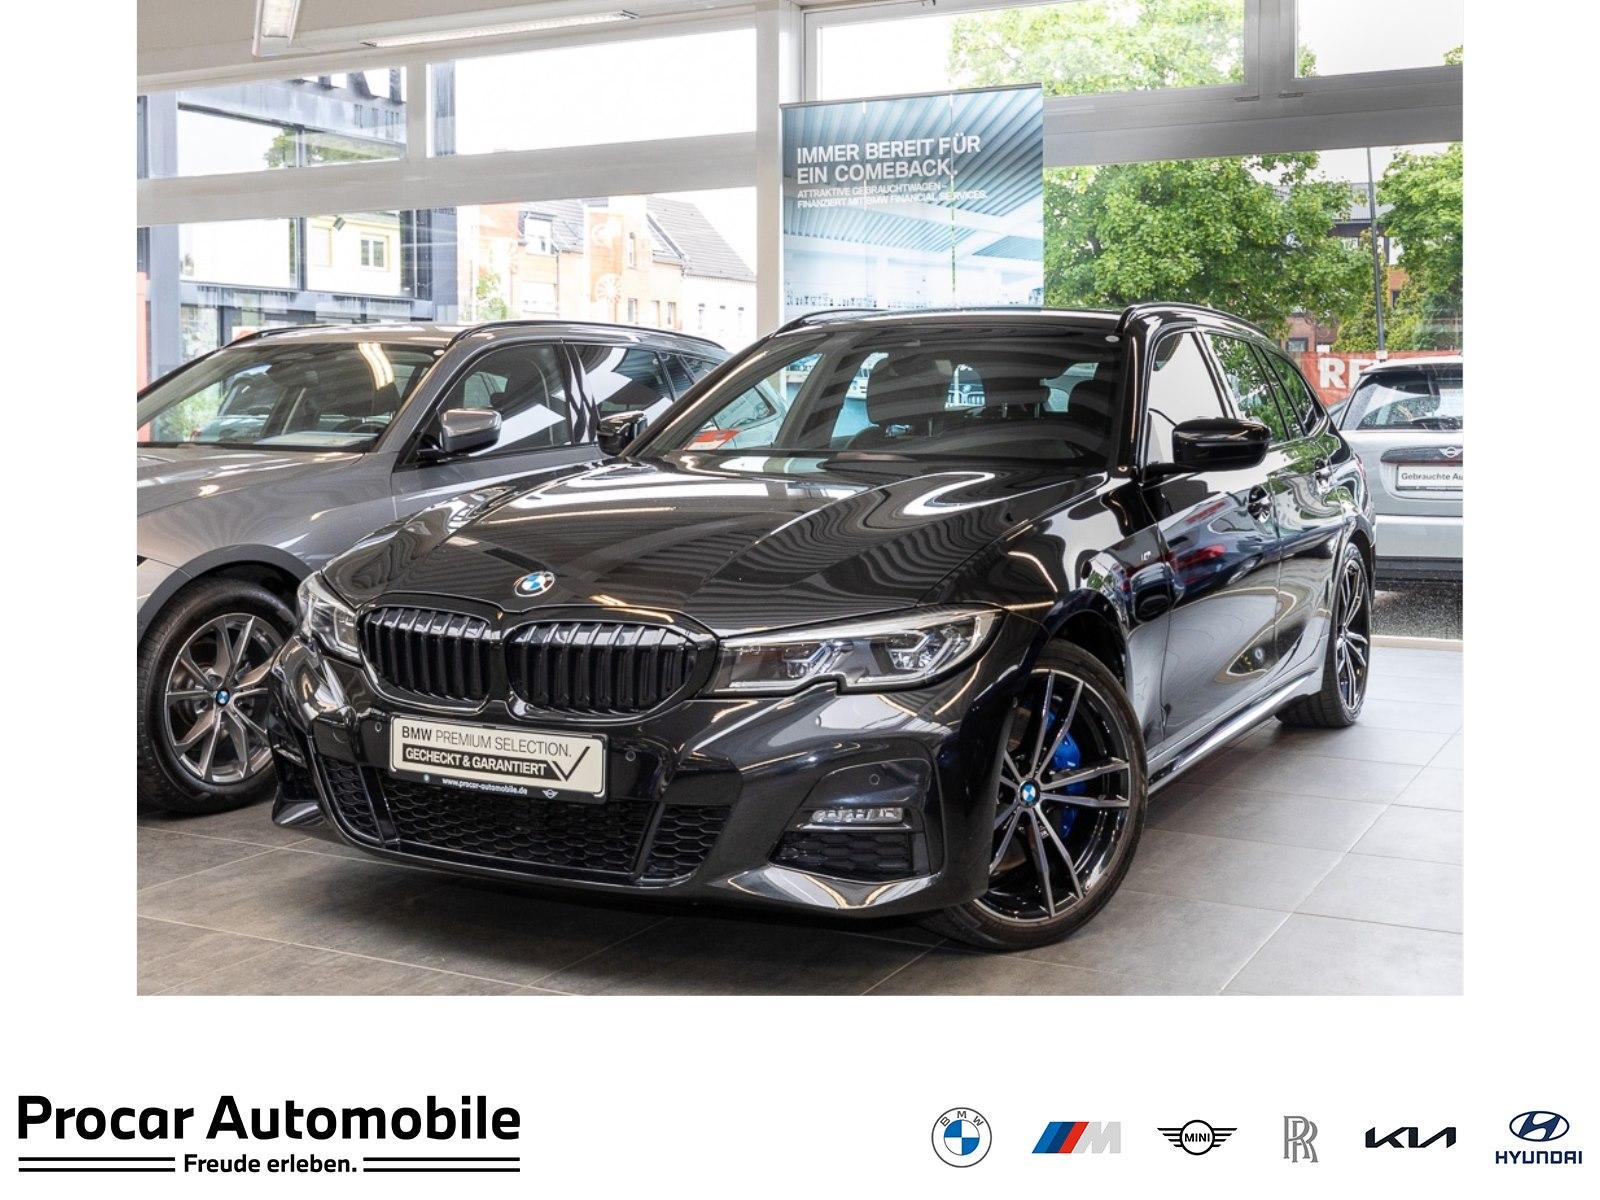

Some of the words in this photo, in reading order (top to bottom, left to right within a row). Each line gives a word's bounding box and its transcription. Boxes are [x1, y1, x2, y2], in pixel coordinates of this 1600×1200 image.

[797, 143, 860, 164] IMMER
[864, 138, 935, 160] BEREIT
[938, 131, 981, 155] FÜR
[797, 165, 828, 185] EIN
[834, 157, 958, 182] COMEBACK.
[797, 187, 850, 199] ATTRAKTIVE
[852, 181, 940, 196] GEBRAUCHTWAGEN
[797, 198, 847, 209] FINANZIERT
[847, 196, 864, 206] MIT
[890, 192, 936, 204] FINANCIAL
[1401, 472, 1450, 481] Gebrauchte
[402, 725, 432, 742] BMW
[436, 730, 492, 749] PREMIUM
[494, 737, 572, 758] SELECTION.
[405, 747, 461, 766] GECHECKT
[462, 756, 471, 768] &
[472, 756, 547, 776] GARANTIERT
[442, 778, 528, 795] www.procar-automobile.de
